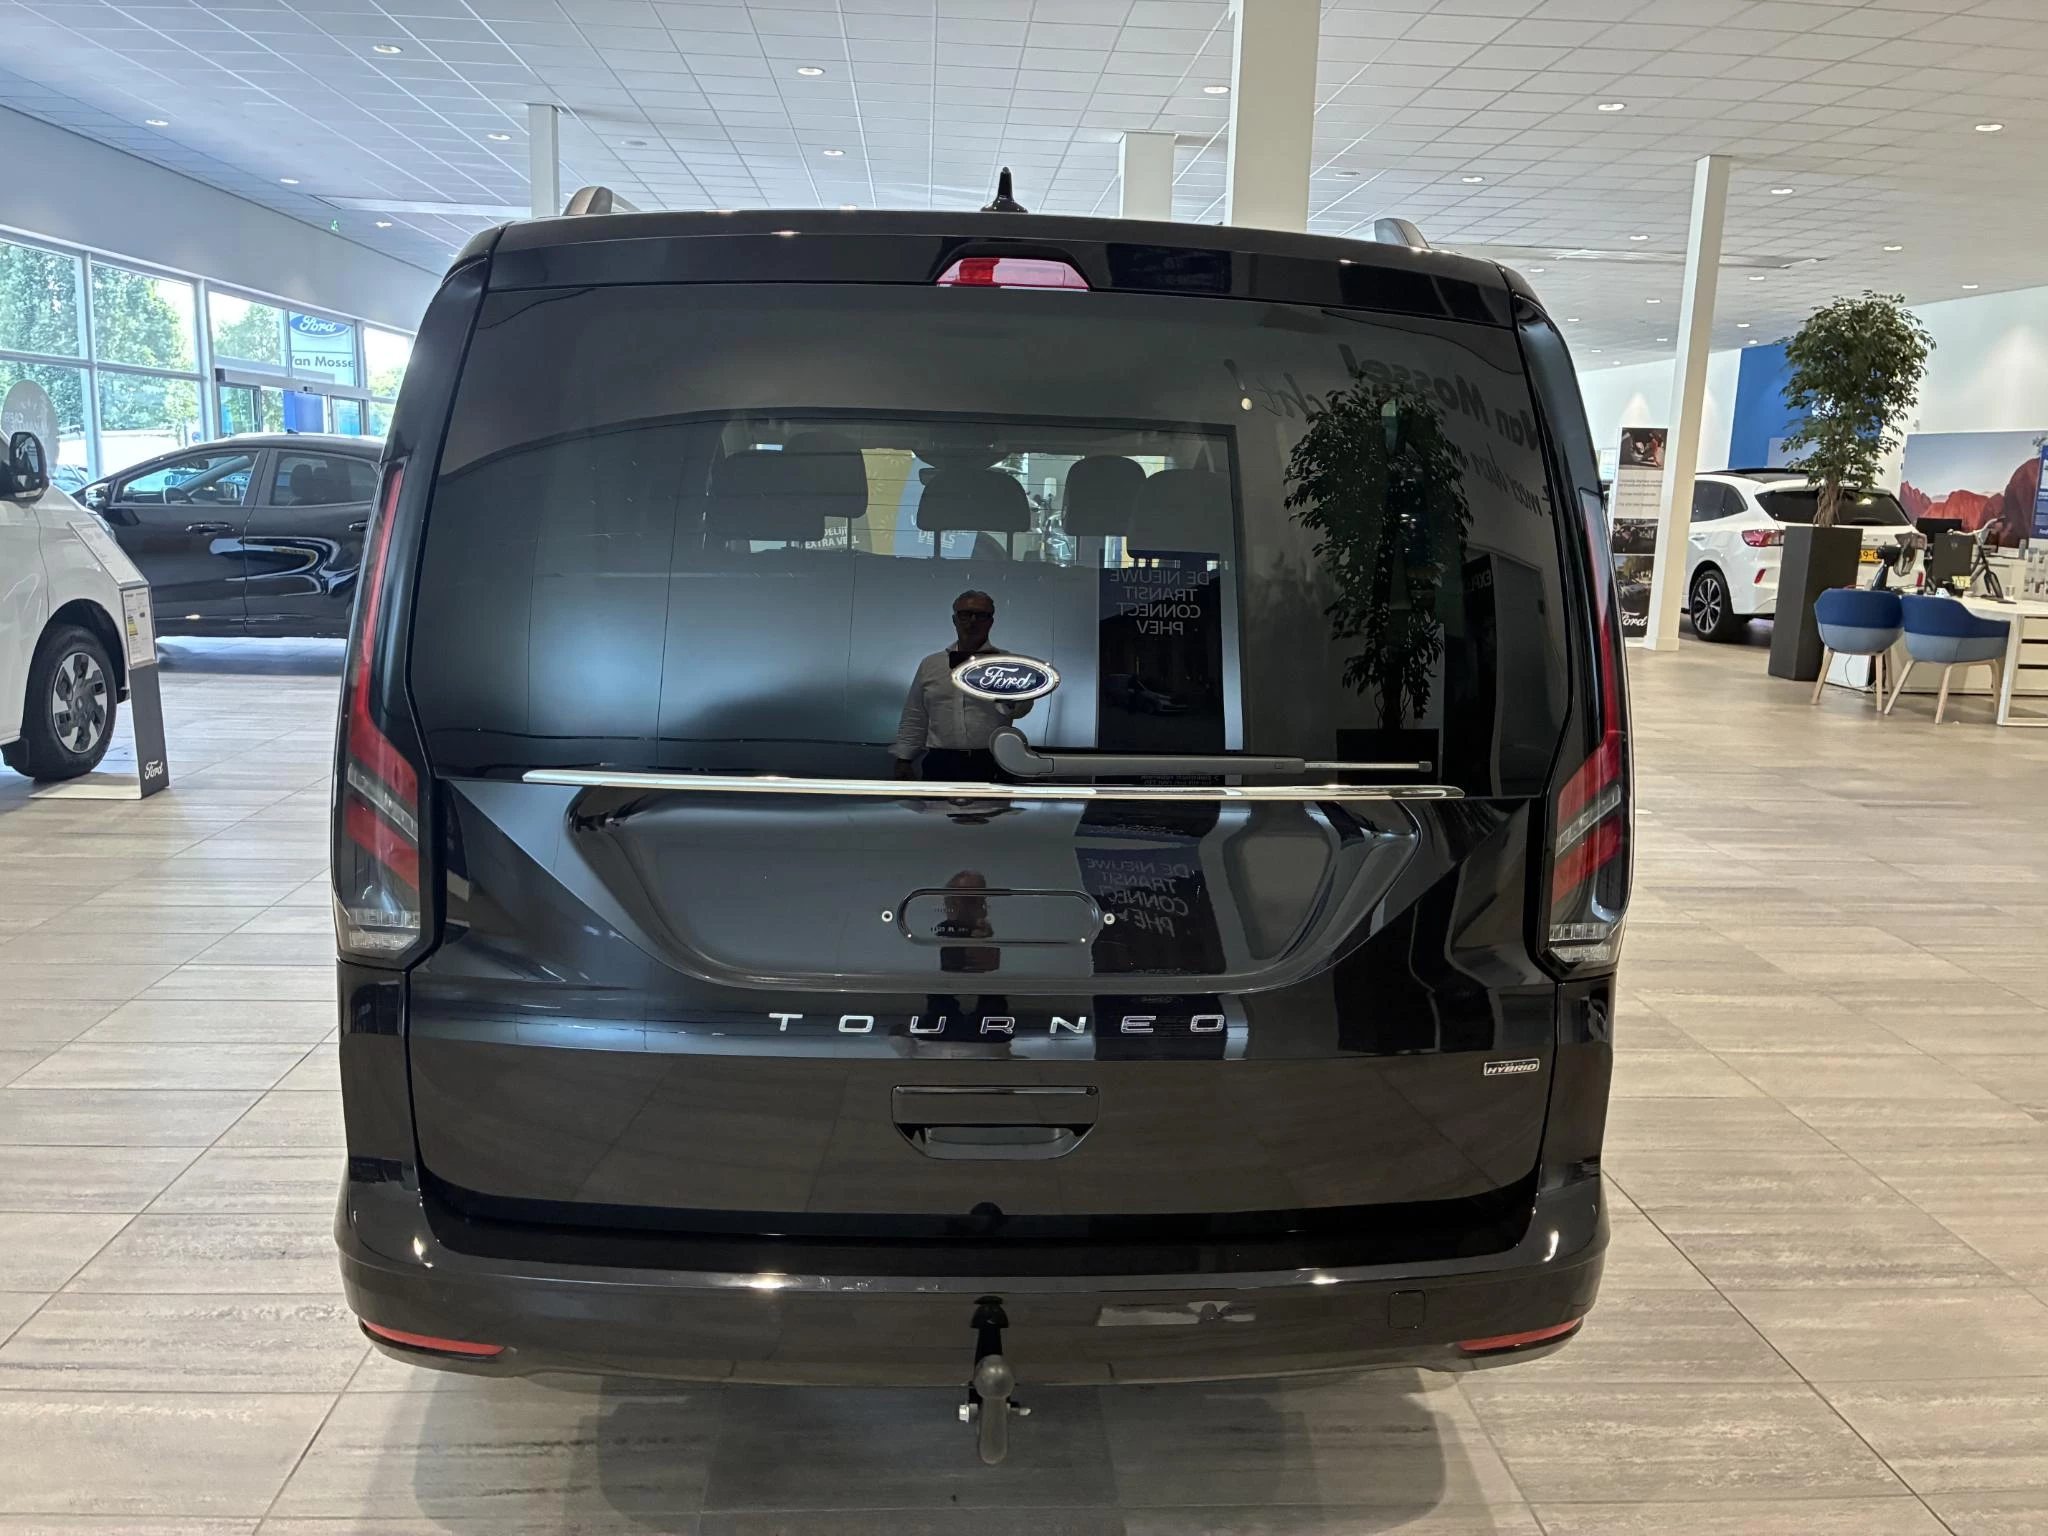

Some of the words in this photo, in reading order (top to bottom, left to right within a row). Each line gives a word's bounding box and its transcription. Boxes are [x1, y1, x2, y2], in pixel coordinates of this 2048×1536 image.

[299, 315, 337, 332] Ford
[978, 665, 1033, 690] Ford
[144, 760, 164, 780] Ford
[768, 1012, 1225, 1034] TOURNEO
[1487, 1063, 1537, 1074] HYBRID
